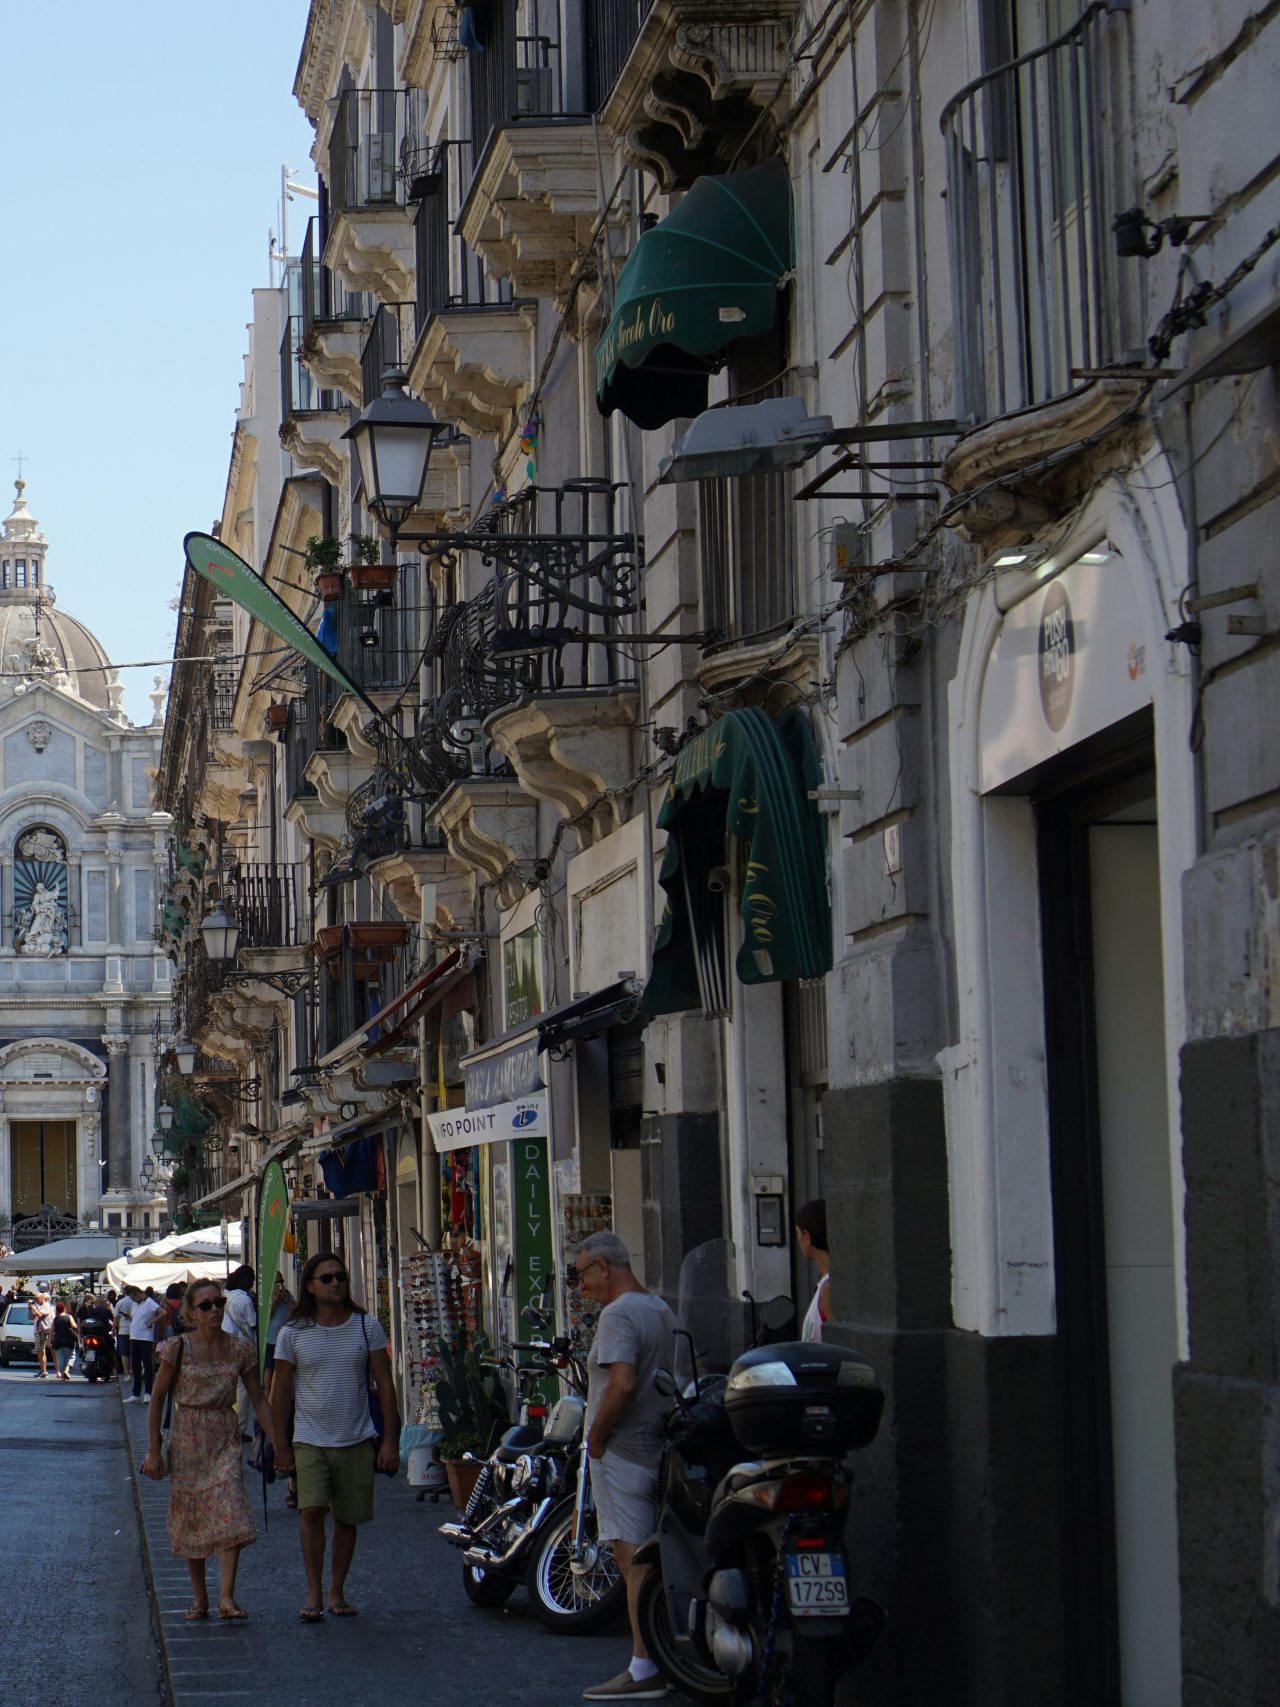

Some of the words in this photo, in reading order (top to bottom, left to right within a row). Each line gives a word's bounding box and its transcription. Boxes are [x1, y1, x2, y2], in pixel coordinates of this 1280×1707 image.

[1044, 604, 1066, 651] PUSH
[1056, 638, 1070, 682] GO
[456, 1113, 496, 1135] POINT
[525, 1144, 544, 1238] DAILY
[800, 1555, 820, 1575] CV
[794, 1581, 846, 1603] 17259
